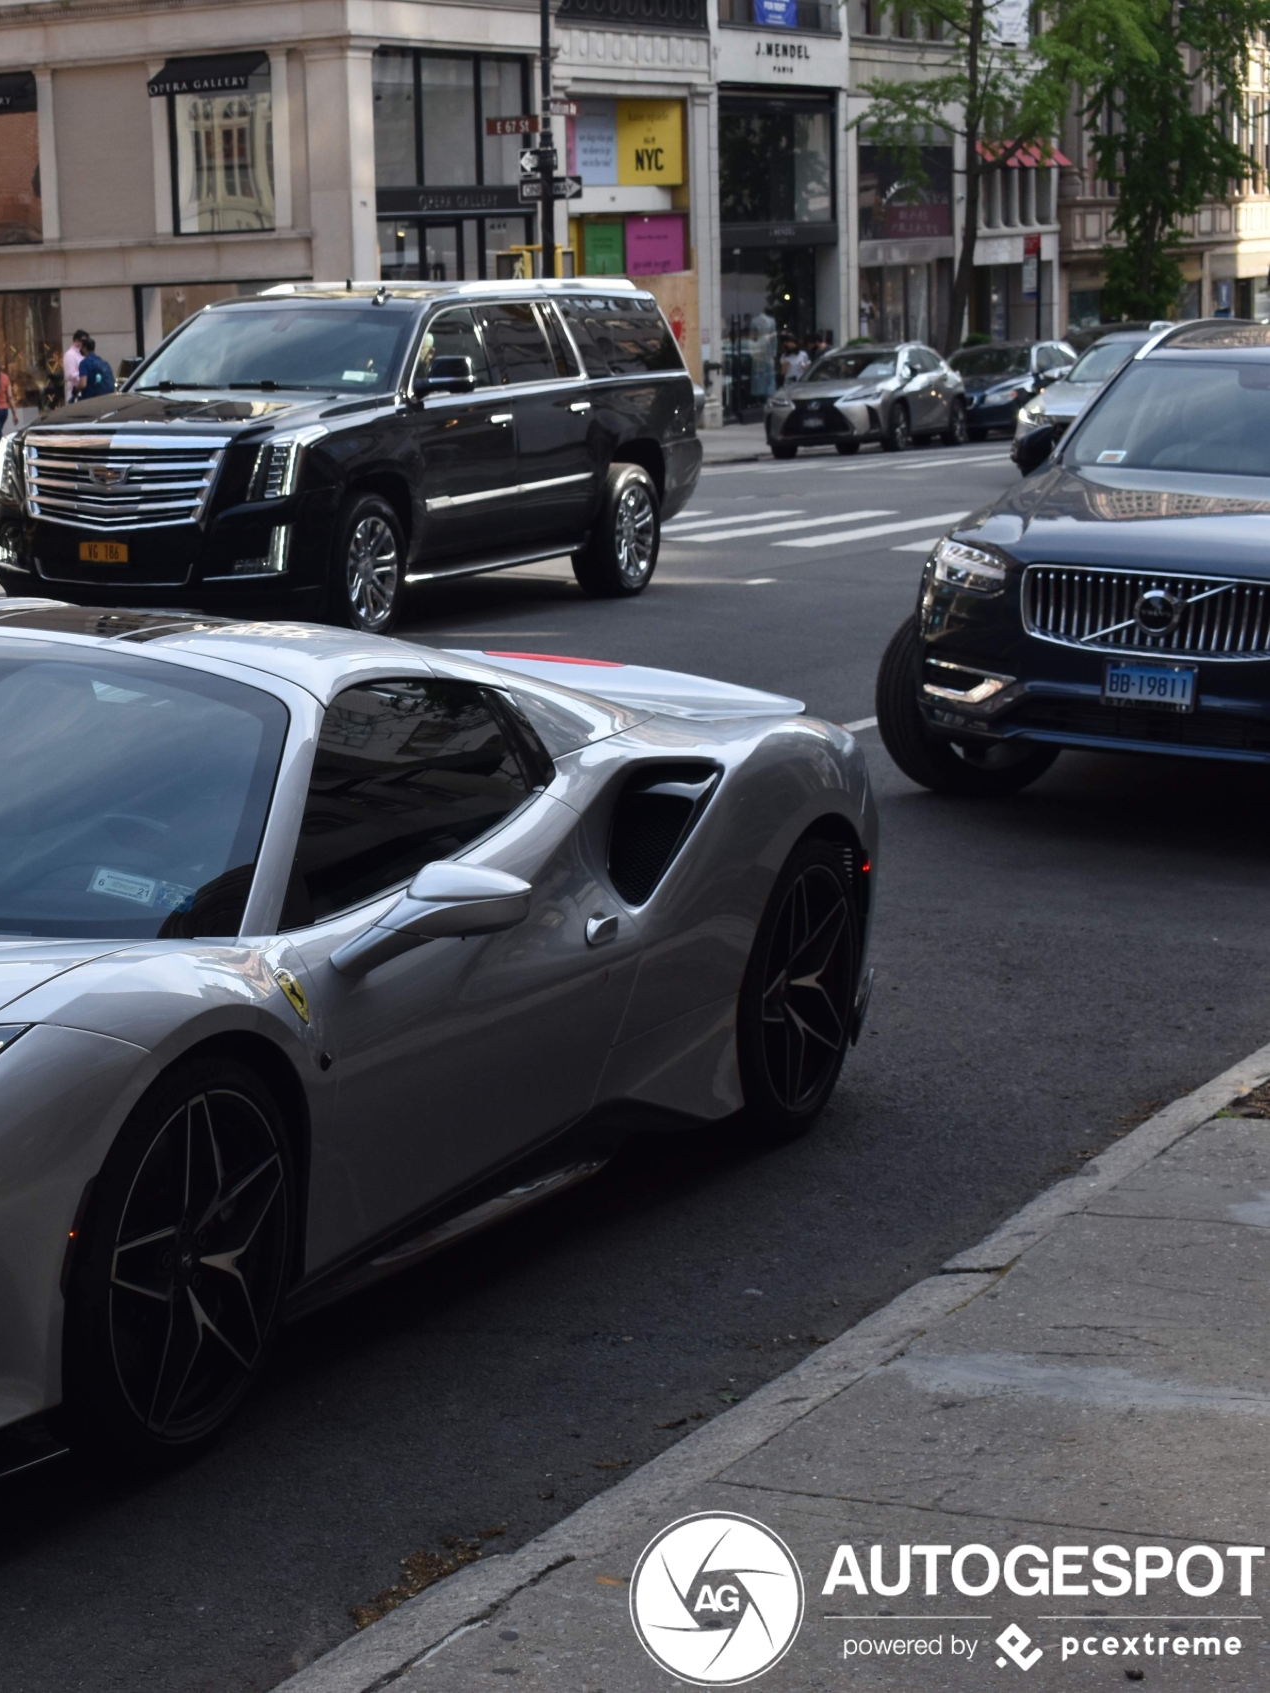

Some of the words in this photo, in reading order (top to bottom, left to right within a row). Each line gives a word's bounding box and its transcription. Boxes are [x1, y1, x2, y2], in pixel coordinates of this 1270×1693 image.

[756, 42, 810, 59] J.MENDEL
[149, 81, 188, 95] OPERA
[193, 76, 246, 90] GALLERY
[496, 121, 502, 134] E
[505, 121, 516, 133] 67
[519, 119, 530, 133] St
[635, 148, 664, 171] NYC
[98, 878, 105, 887] 6
[136, 887, 150, 898] 21
